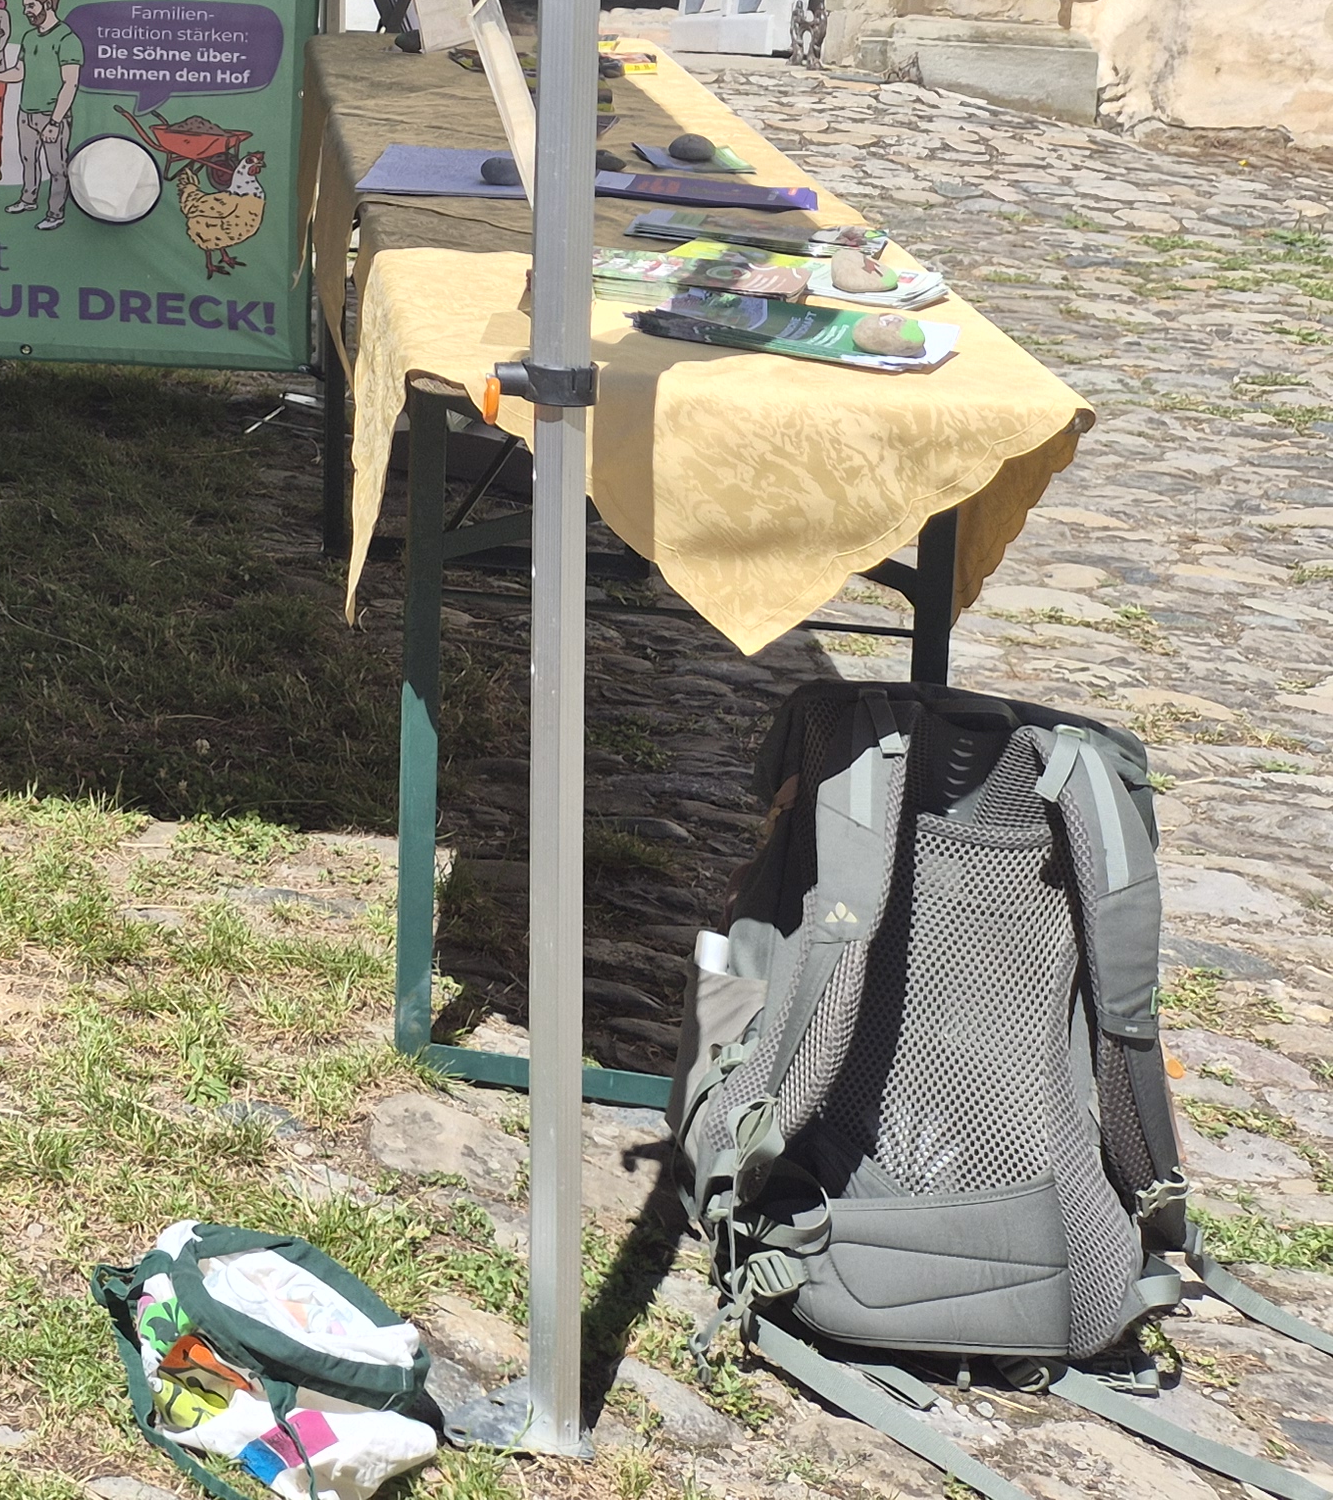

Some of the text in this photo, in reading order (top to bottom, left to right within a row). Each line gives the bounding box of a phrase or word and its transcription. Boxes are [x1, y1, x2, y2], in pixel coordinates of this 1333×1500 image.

[131, 5, 215, 21] Familien-
[96, 25, 248, 42] tradition stärken:
[97, 43, 247, 63] Die Söhne über-
[93, 65, 251, 83] nehmen den Hof
[78, 288, 276, 334] DRECK!
